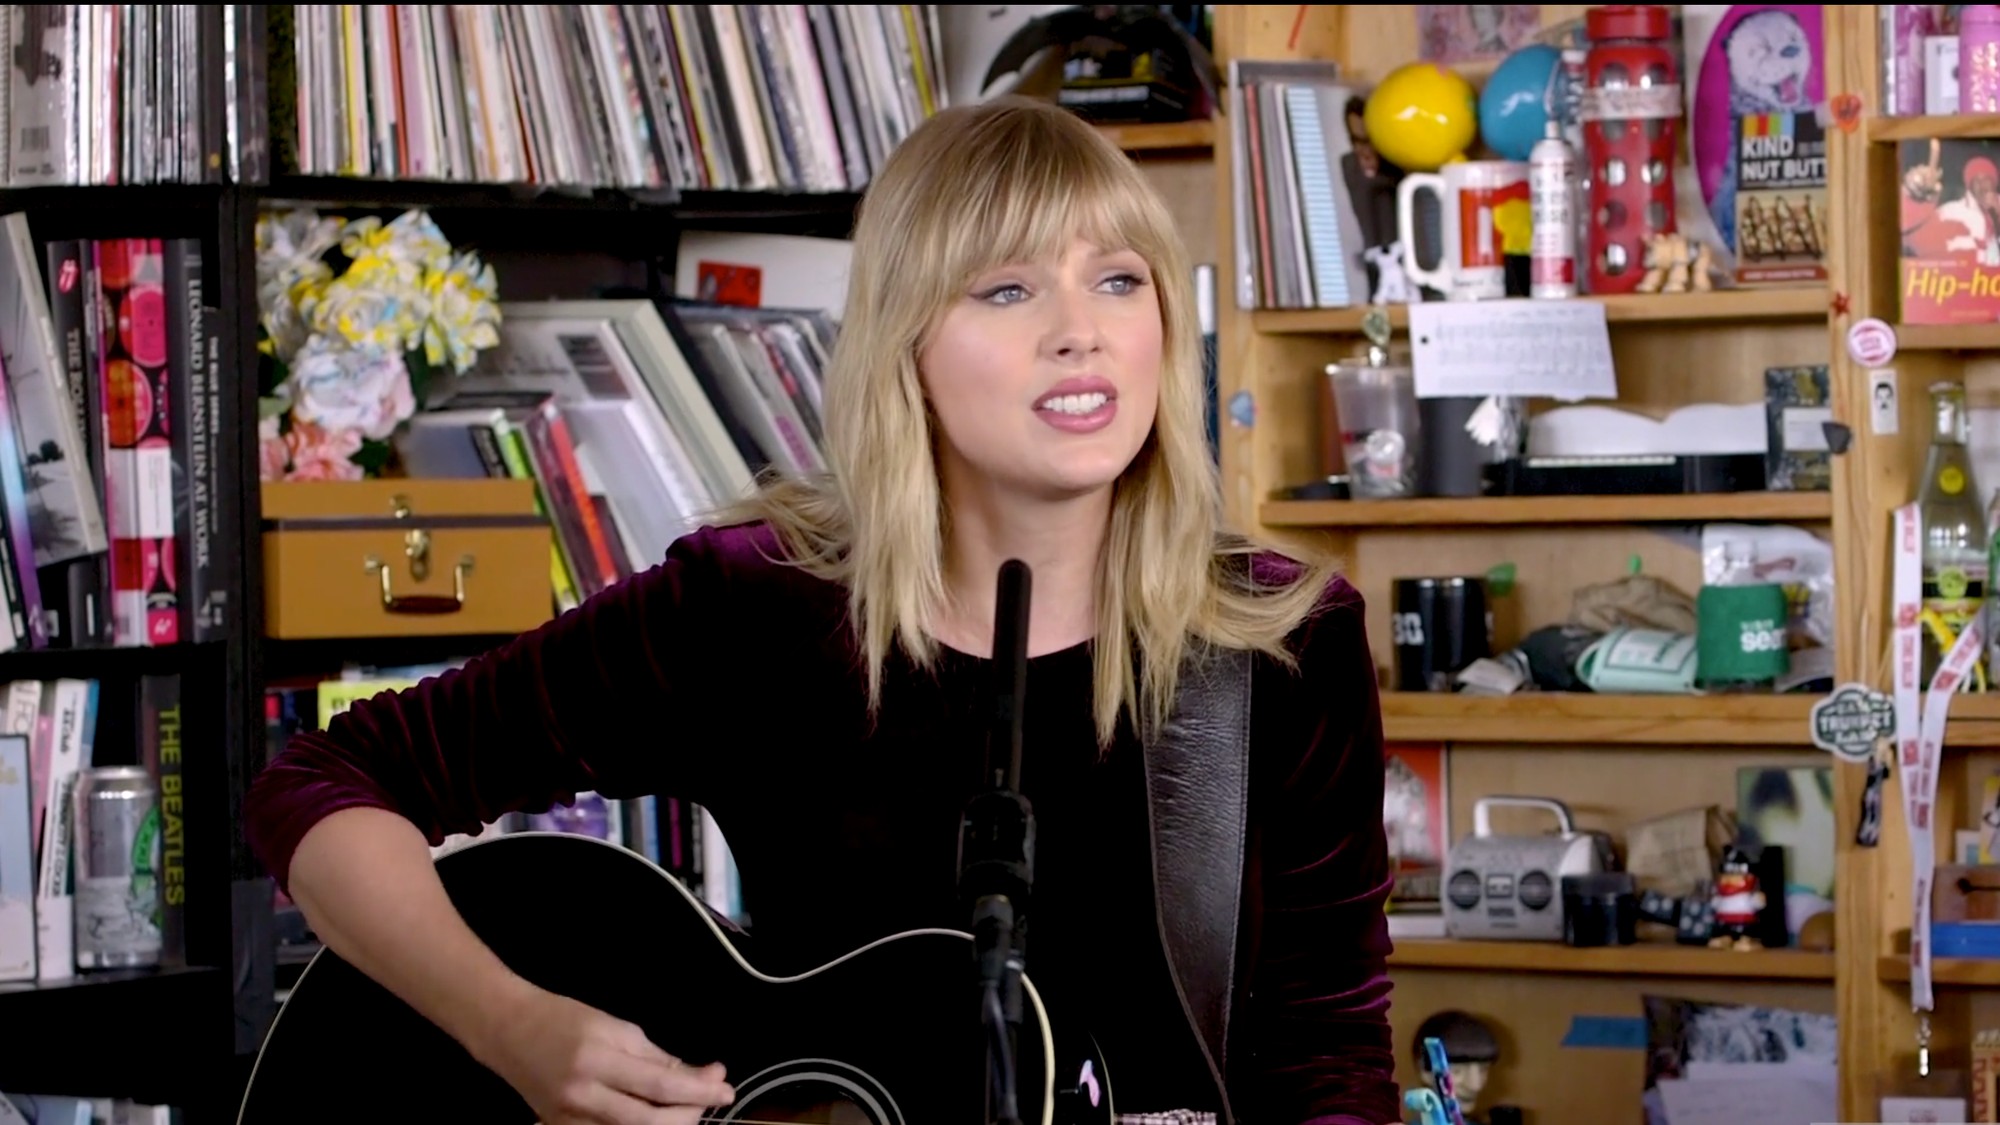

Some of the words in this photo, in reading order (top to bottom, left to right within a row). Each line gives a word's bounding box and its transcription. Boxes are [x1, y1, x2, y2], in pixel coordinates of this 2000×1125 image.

[1742, 136, 1795, 159] KIND
[1742, 161, 1780, 180] NUT
[67, 328, 82, 369] THE
[189, 280, 204, 369] LEONARD
[195, 481, 209, 502] AT
[196, 508, 210, 568] WORK
[159, 705, 181, 764] THE
[162, 774, 185, 905] BEATLES
